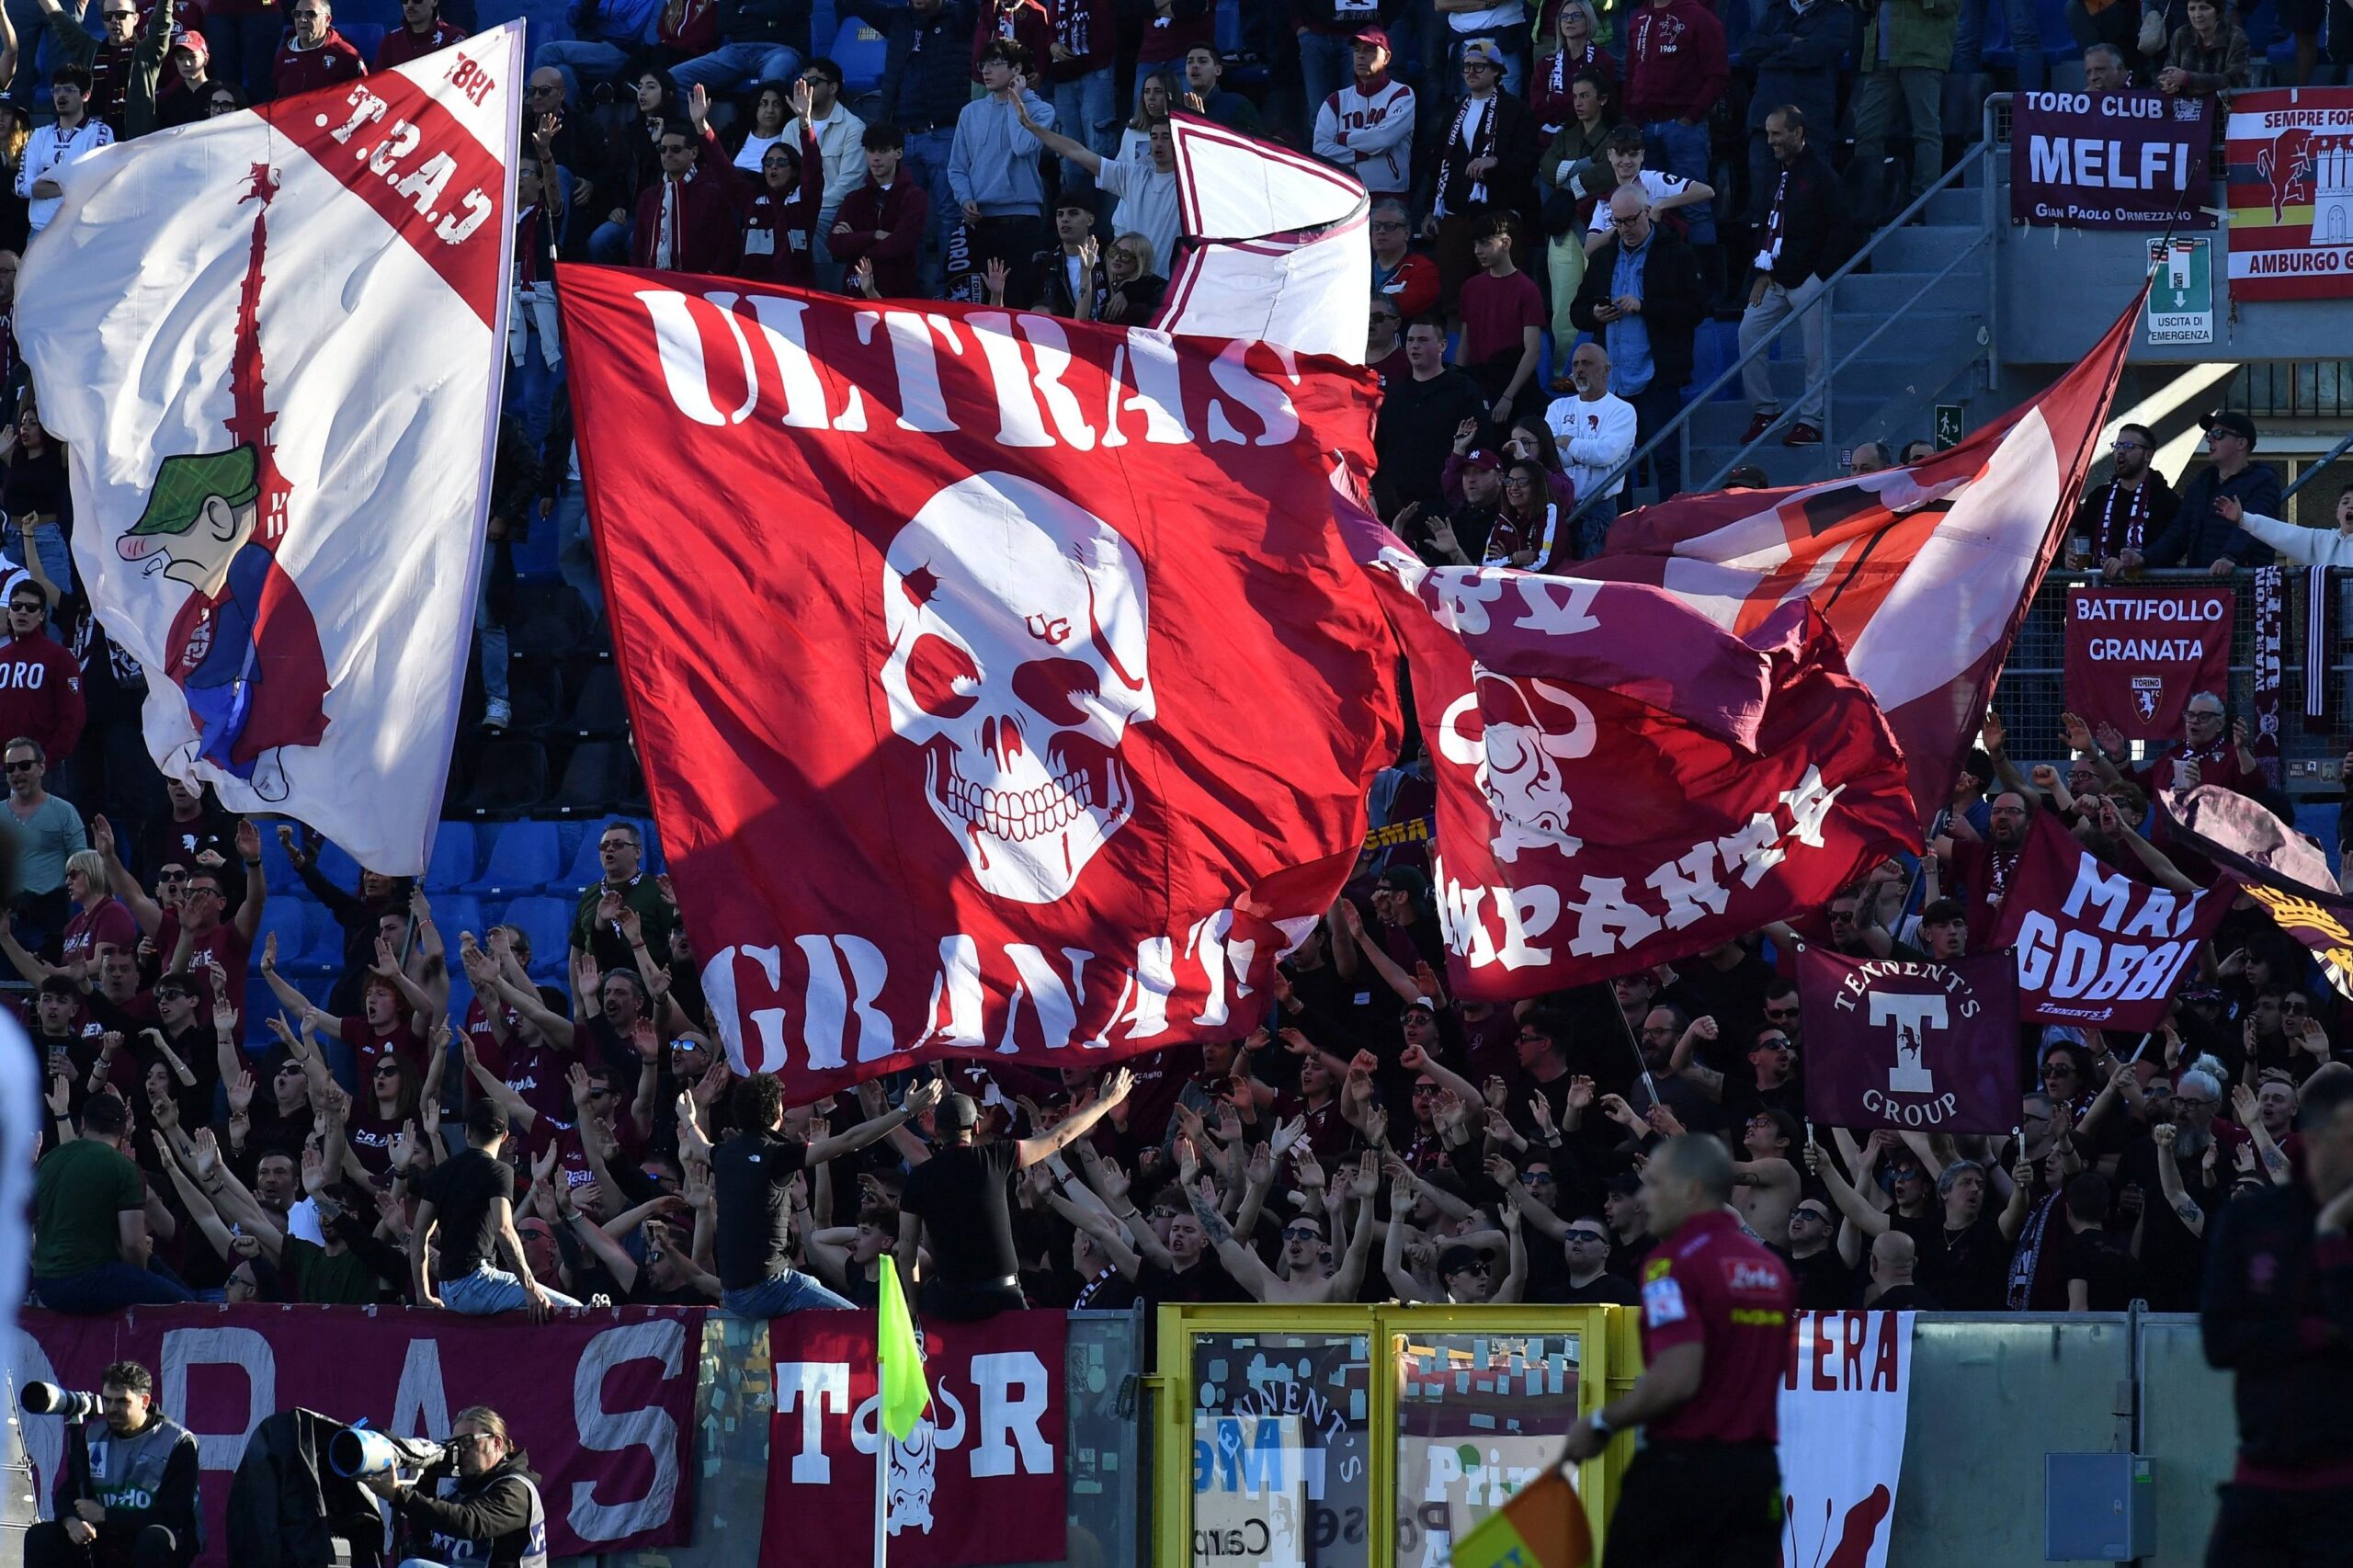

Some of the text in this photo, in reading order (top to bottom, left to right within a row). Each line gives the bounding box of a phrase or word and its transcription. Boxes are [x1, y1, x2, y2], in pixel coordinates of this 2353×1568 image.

[1659, 45, 1677, 53] 1969
[2025, 91, 2164, 119] TORO CLUB
[2264, 110, 2325, 129] SEMPRE
[2029, 134, 2189, 191] MELFI
[948, 225, 972, 272] TORO
[2249, 251, 2339, 274] AMBURGO
[2151, 330, 2210, 341] EMERGENZA
[2157, 316, 2203, 327] USCITA DI
[634, 290, 1300, 451] ULTRAS
[2076, 598, 2224, 622] BATTIFOLLO
[2089, 639, 2204, 662] GRANATA
[2134, 679, 2160, 687] TORINO
[2062, 851, 2210, 939] MAI
[2016, 908, 2200, 1002] GOBBI
[1834, 959, 1982, 1019] TENNENT'S
[1869, 990, 1949, 1094] T
[1862, 1087, 1958, 1128] GROUP
